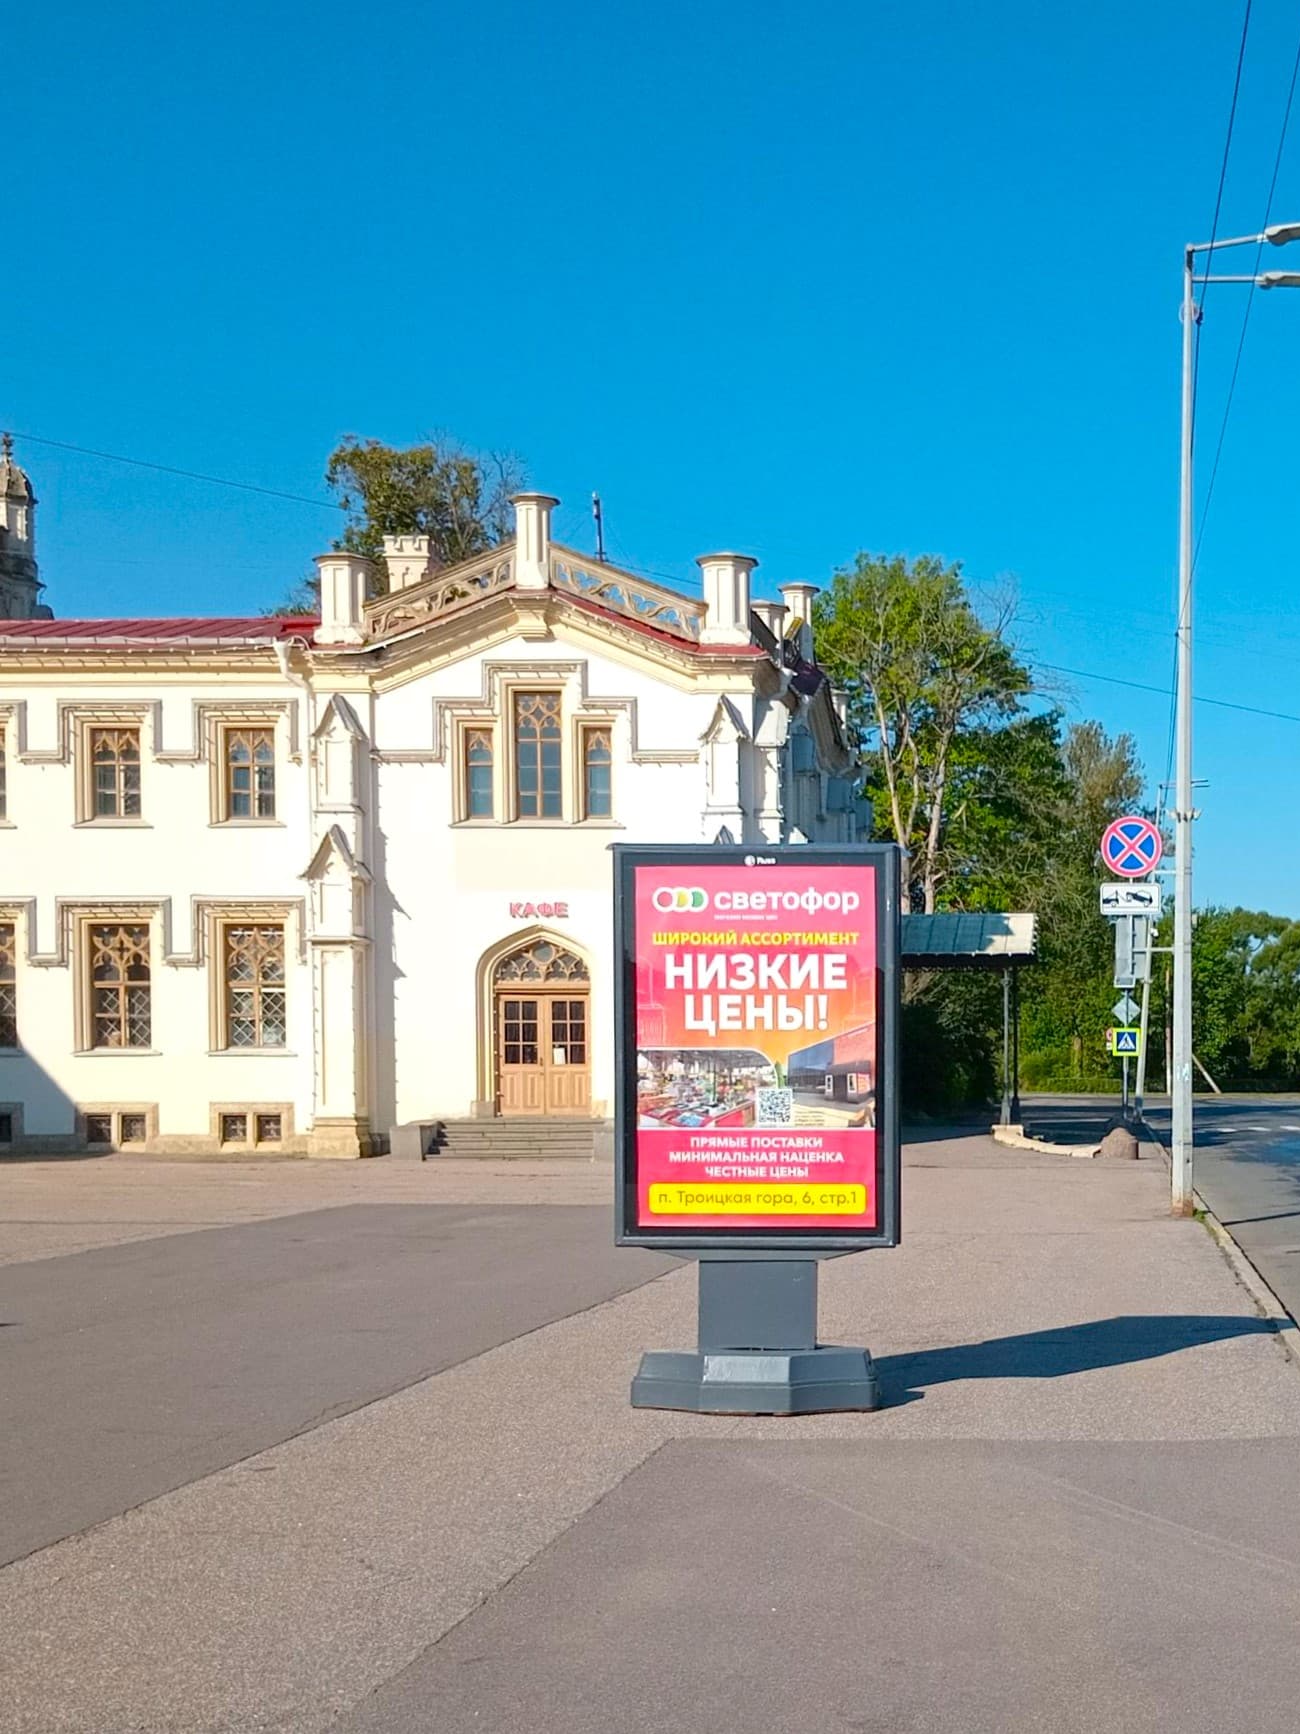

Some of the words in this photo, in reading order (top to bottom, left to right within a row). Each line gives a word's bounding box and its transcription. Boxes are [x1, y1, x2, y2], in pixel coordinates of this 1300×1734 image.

[714, 887, 860, 915] светофор
[509, 902, 569, 918] КАФЕ
[652, 931, 737, 945] ШИРОКИЙ
[740, 932, 859, 945] АССОРТИМЕНТ
[665, 953, 847, 989] НИЗКИЕ
[684, 994, 828, 1036] ЦЕНЫ!
[690, 1137, 748, 1148] ПРЯМЫЕ
[751, 1137, 823, 1148] ПОСТАВКИ
[669, 1152, 777, 1163] МИНИМАЛЬНАЯ
[780, 1152, 844, 1164] НАЦЕНКА
[705, 1167, 767, 1178] ЧЕСТНЫЕ
[770, 1167, 808, 1178] ЦЕНЫ
[658, 1193, 672, 1203] п.
[677, 1191, 752, 1206] Троицкая
[756, 1194, 797, 1207] гора,
[802, 1191, 815, 1206] 6,
[820, 1192, 856, 1207] стр.1
